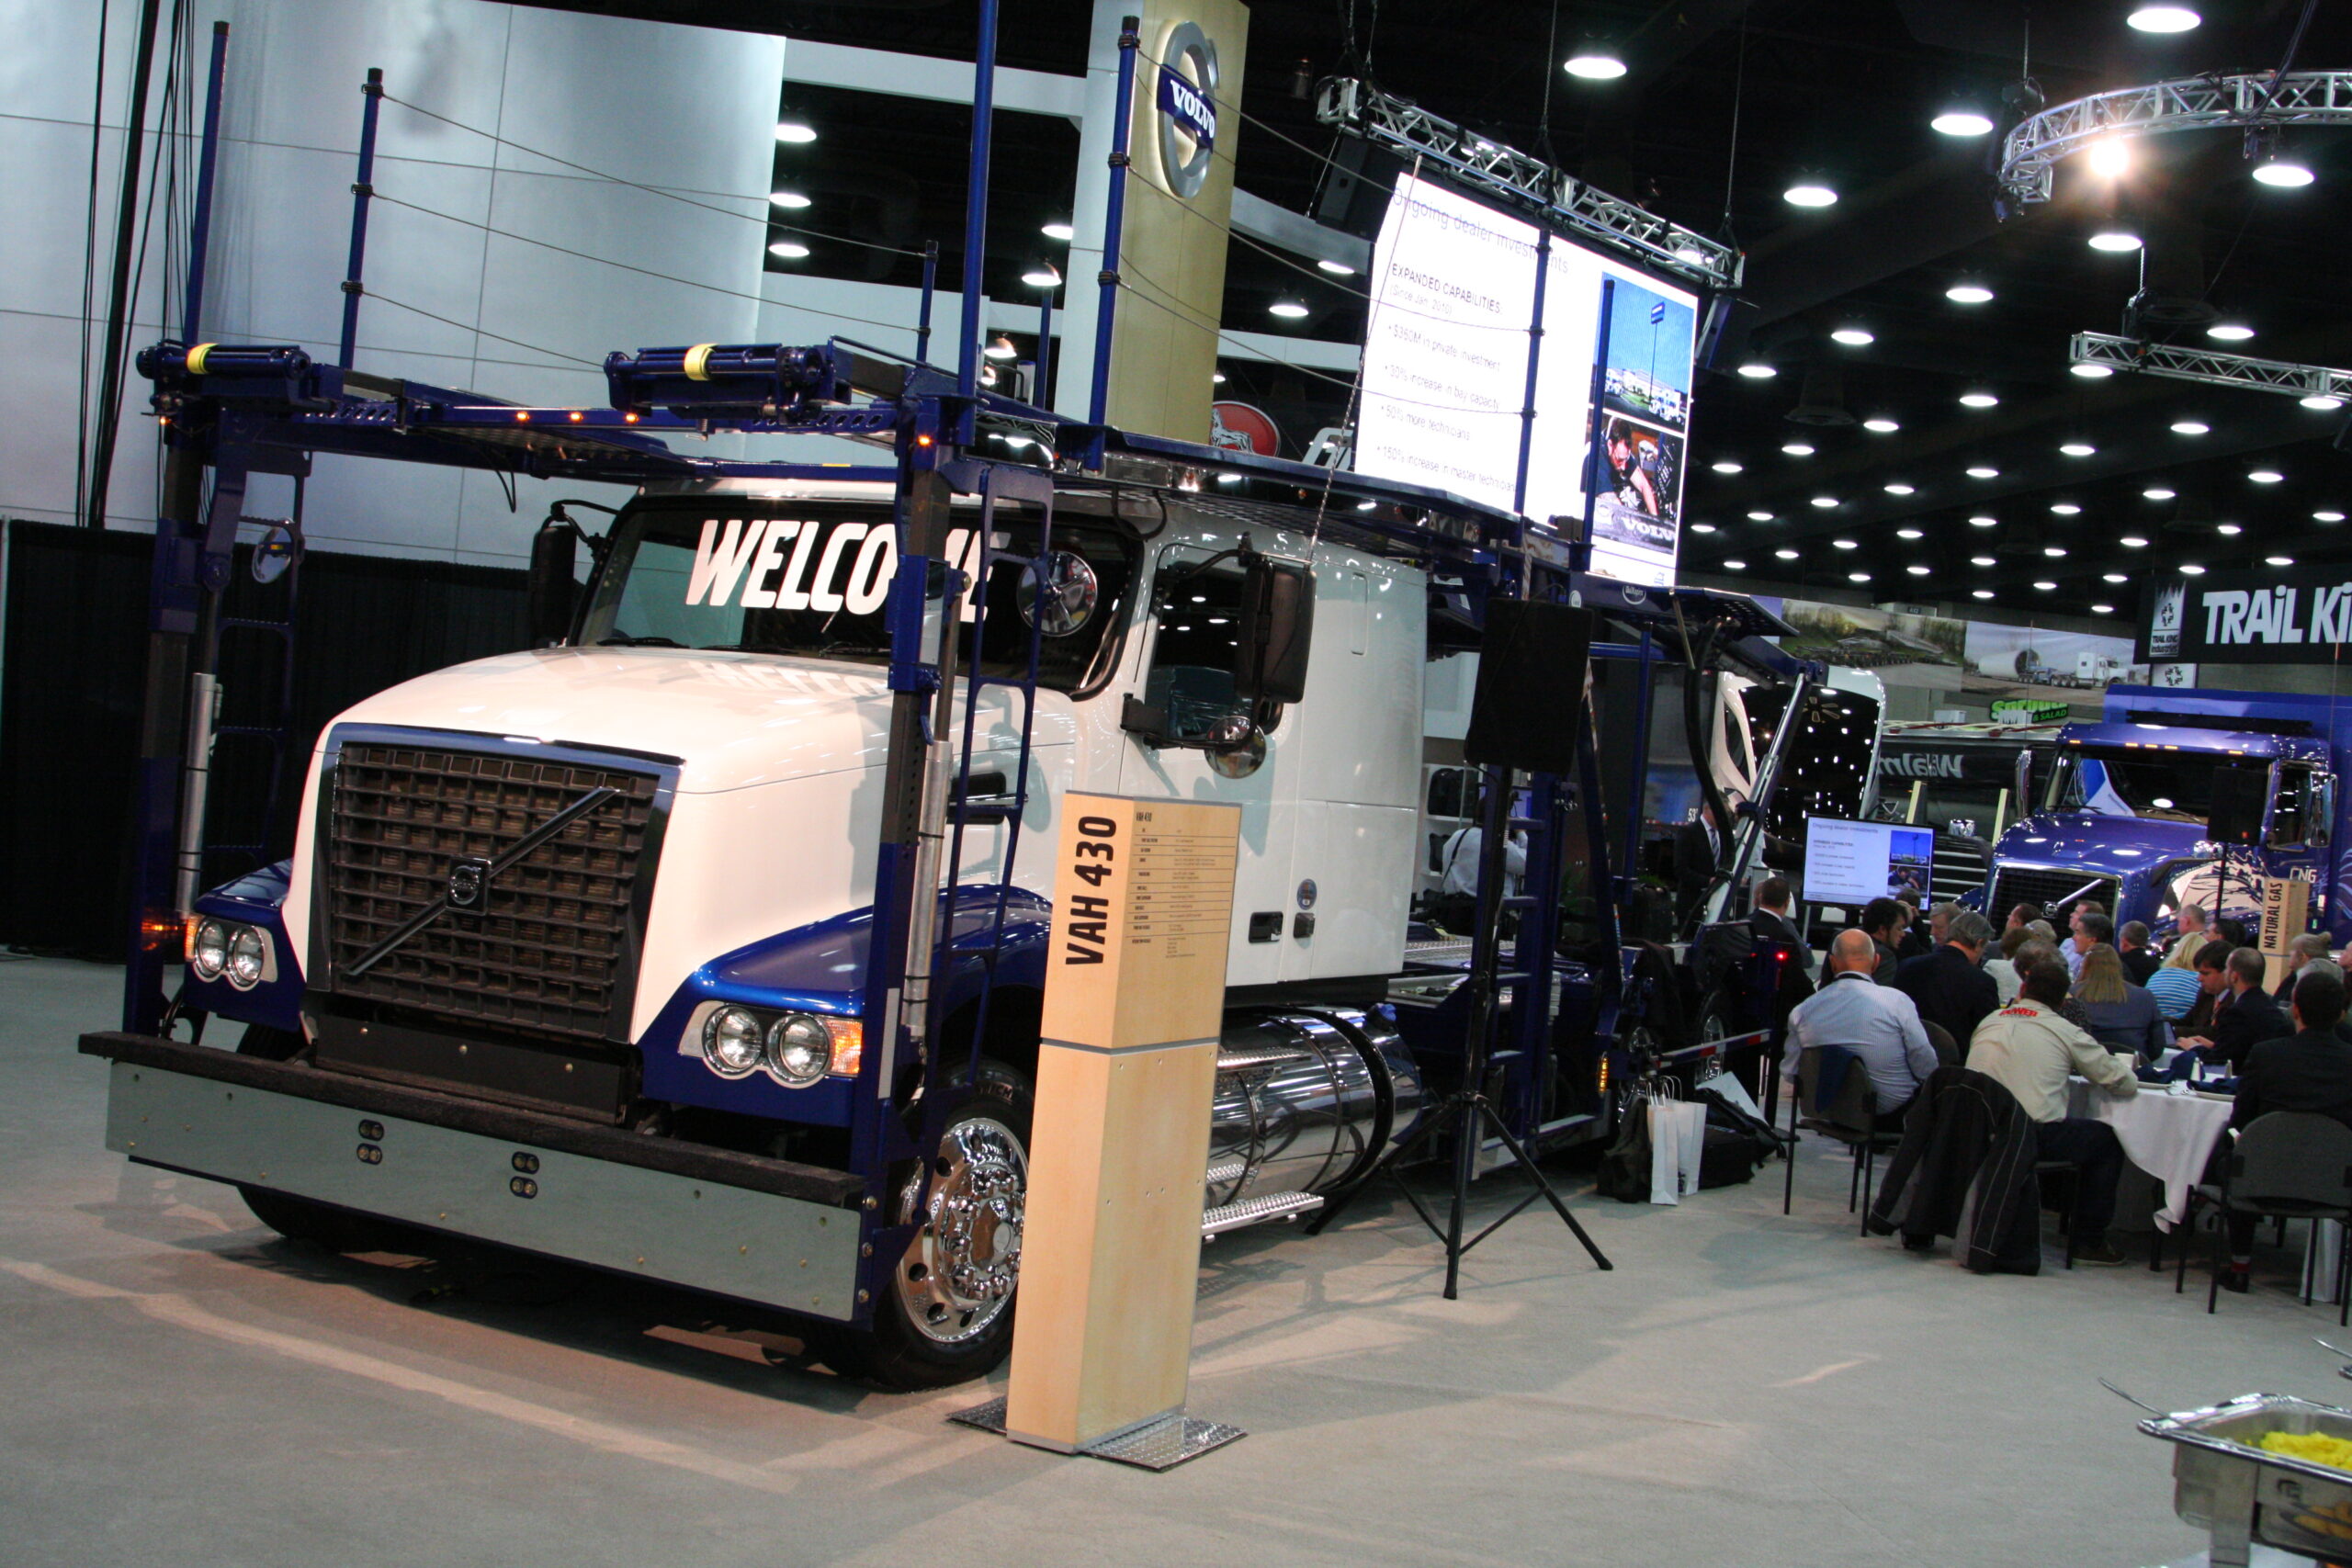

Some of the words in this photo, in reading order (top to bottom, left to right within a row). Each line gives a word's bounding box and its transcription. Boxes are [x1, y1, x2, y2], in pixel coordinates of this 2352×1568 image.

[1170, 79, 1216, 139] VOLVO
[1392, 187, 1449, 230] Ongoing
[1454, 214, 1493, 242] dealer
[1392, 263, 1441, 292] EXPANDED
[1431, 341, 1457, 357] private
[1461, 350, 1500, 372] investment
[1409, 374, 1442, 392] increase
[1454, 385, 1467, 403] bay
[1470, 392, 1500, 412] capacity
[1406, 412, 1426, 428] more
[1428, 419, 1471, 441] technicians
[1407, 455, 1440, 473] increase
[1450, 467, 1477, 482] master
[2040, 709, 2067, 721] SALAD
[1073, 816, 1117, 887] 430
[2289, 867, 2318, 884] CNG
[2268, 883, 2283, 902] GAS
[1066, 895, 1110, 965] VAH
[2263, 905, 2280, 949] NATURAL
